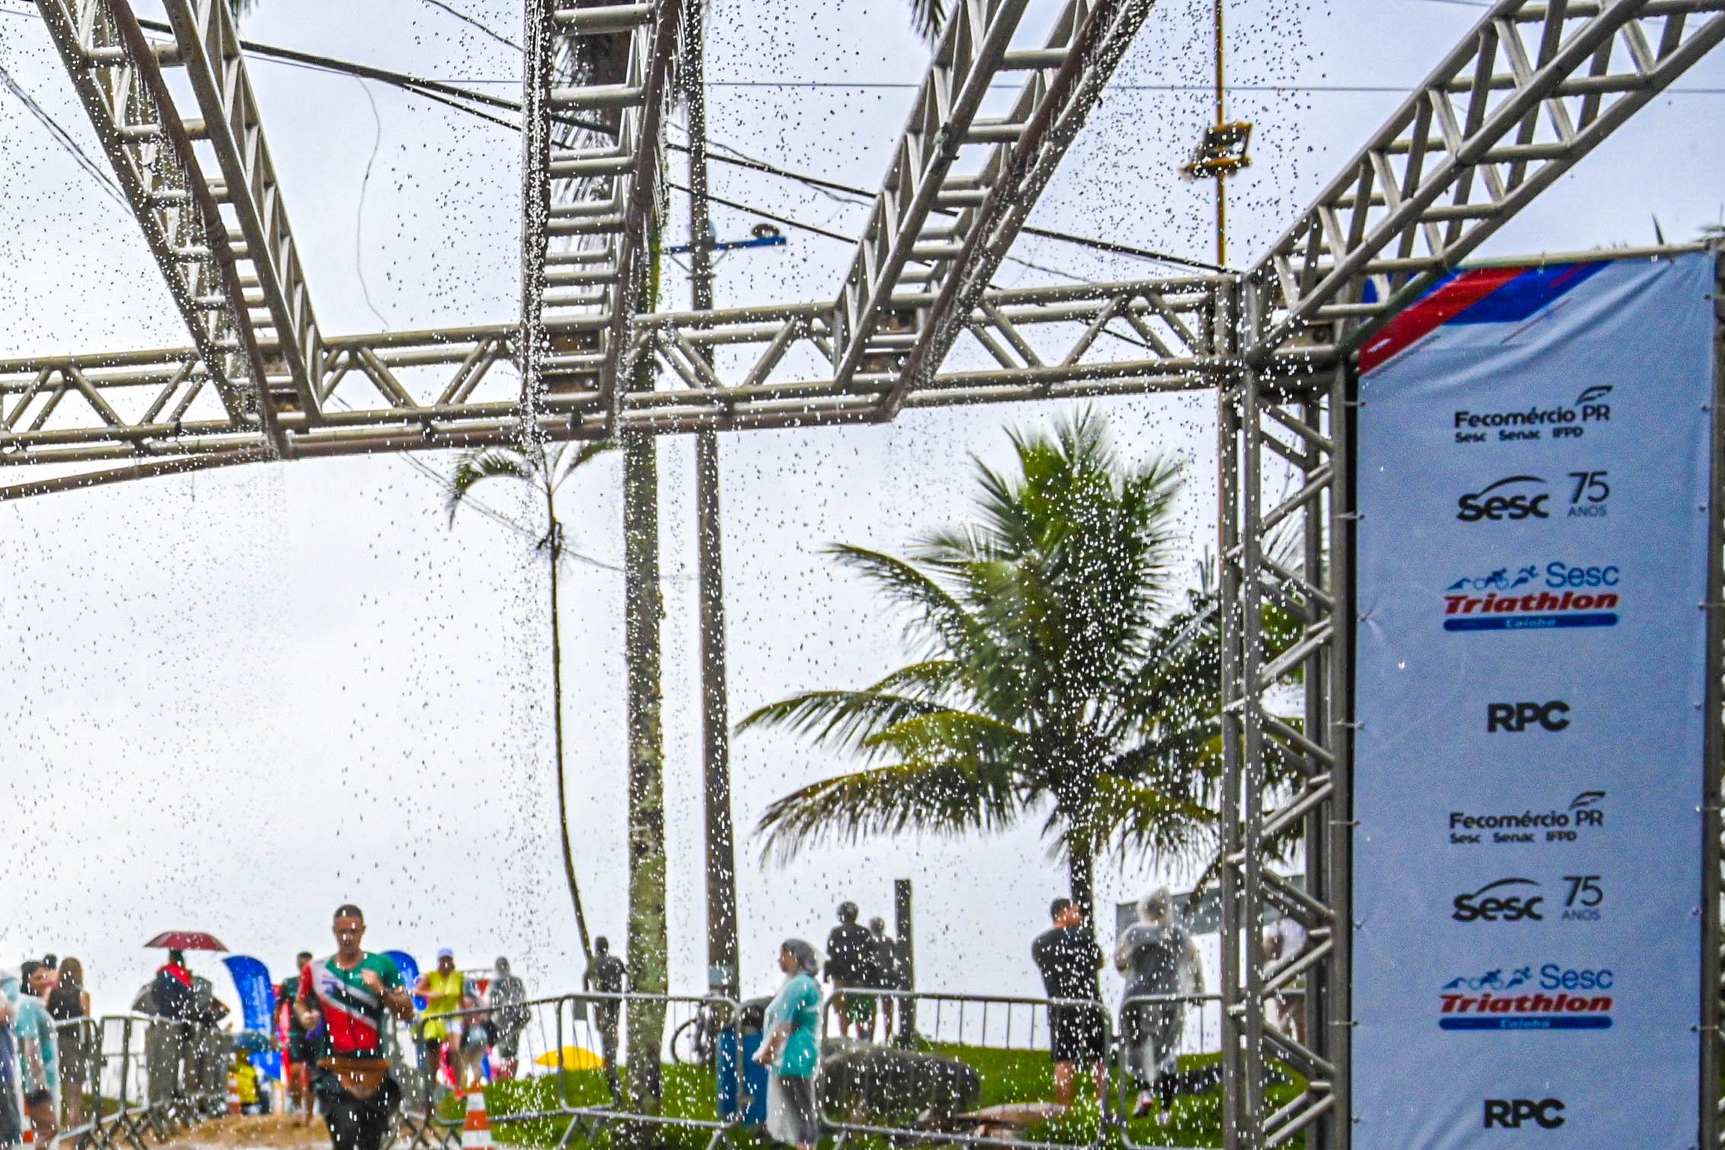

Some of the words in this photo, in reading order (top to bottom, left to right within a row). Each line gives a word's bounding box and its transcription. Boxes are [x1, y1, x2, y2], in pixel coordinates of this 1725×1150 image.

[1454, 406, 1575, 428] Fecomércio
[1582, 404, 1611, 422] PR
[1454, 431, 1487, 444] Sesc
[1498, 429, 1541, 442] Senac
[1568, 470, 1610, 504] 75
[1567, 505, 1608, 517] ANOS
[1545, 561, 1620, 588] Sesc
[1443, 591, 1620, 615] Triathlon
[1486, 700, 1571, 733] RPC
[1449, 809, 1570, 829] Fecomércio
[1576, 809, 1604, 827] PR
[1450, 832, 1481, 844] Sesc
[1493, 831, 1535, 843] Senac
[1561, 874, 1604, 907] 75
[1561, 908, 1602, 921] ANOS
[1539, 963, 1613, 990] Sesc
[1439, 993, 1613, 1013] Triathlon
[1483, 1097, 1566, 1130] RPC
